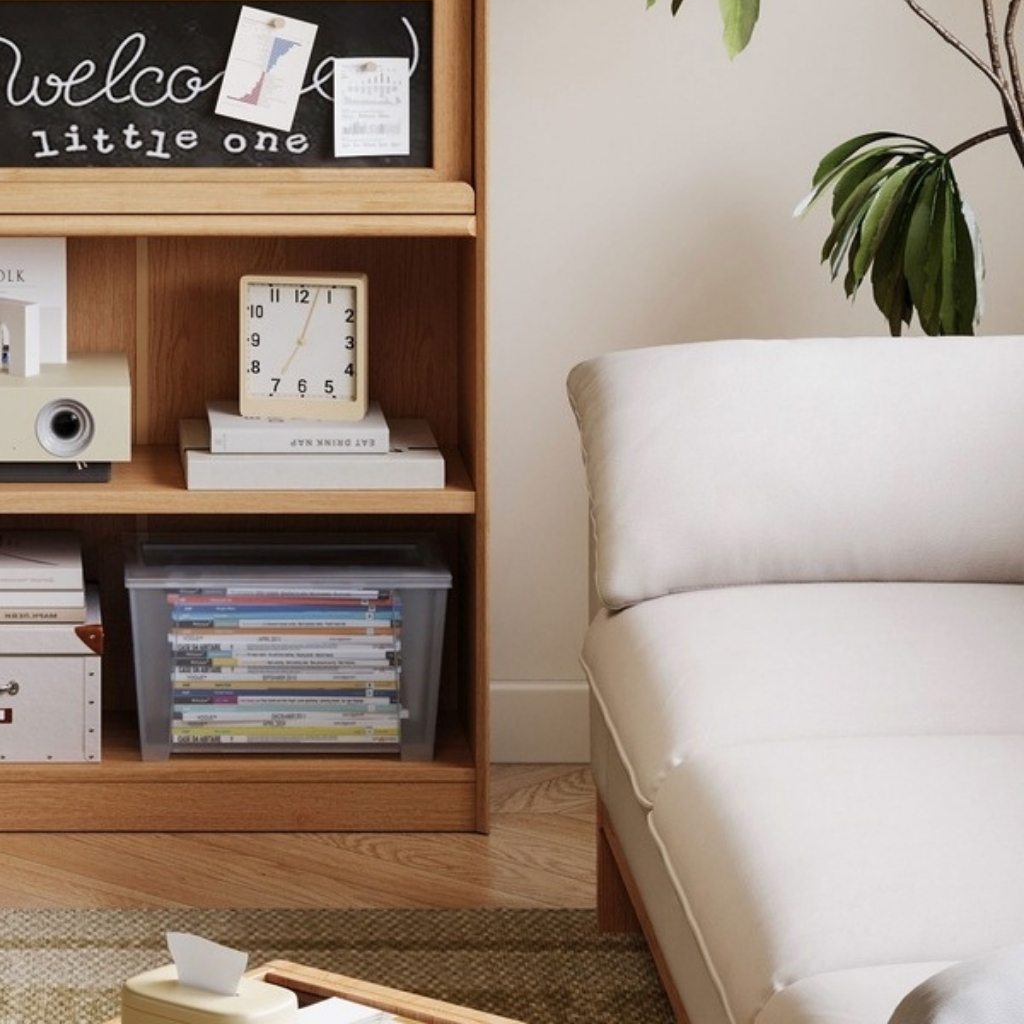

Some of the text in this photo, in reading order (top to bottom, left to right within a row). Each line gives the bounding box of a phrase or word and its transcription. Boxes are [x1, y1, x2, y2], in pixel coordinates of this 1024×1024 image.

[33, 123, 310, 158] little one
[269, 288, 332, 304] 11 12 1
[250, 305, 264, 319] 10
[344, 309, 355, 323] 2
[250, 333, 261, 347] 9
[344, 336, 355, 350] 3
[250, 360, 261, 374] 8
[344, 363, 355, 377] 4
[271, 378, 334, 394] 7 6 5
[290, 439, 375, 447] EAT DRINK NAP
